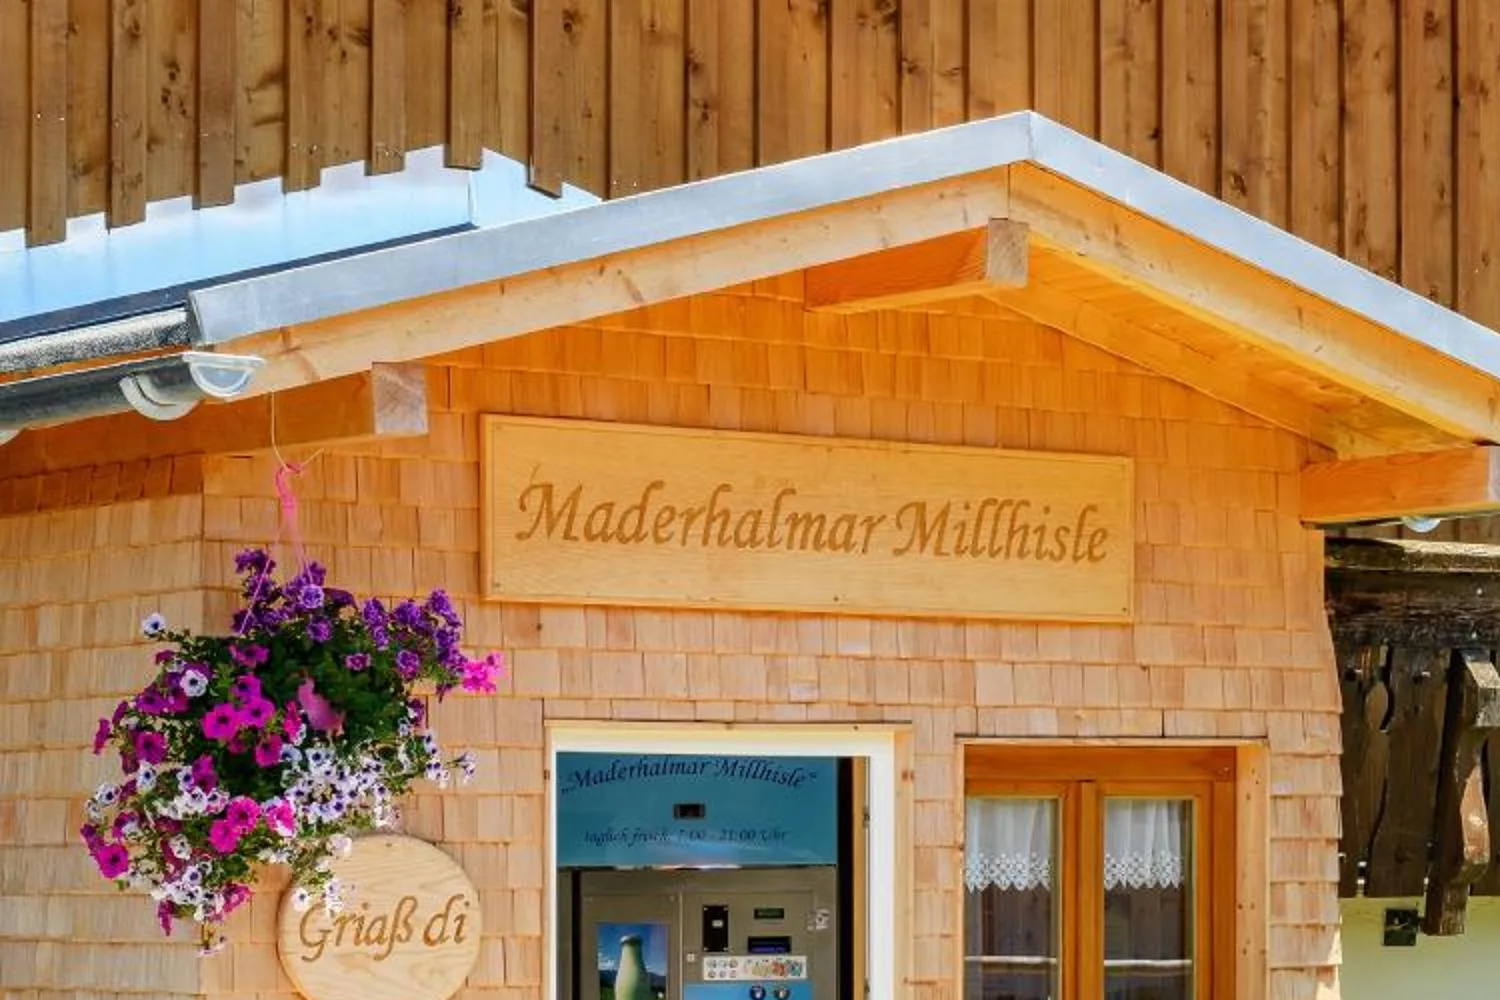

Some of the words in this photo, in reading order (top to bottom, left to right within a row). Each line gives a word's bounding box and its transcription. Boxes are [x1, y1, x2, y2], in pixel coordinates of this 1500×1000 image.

[516, 464, 886, 555] Maderhalmar
[893, 496, 1109, 564] Millhisle
[423, 894, 470, 946] di
